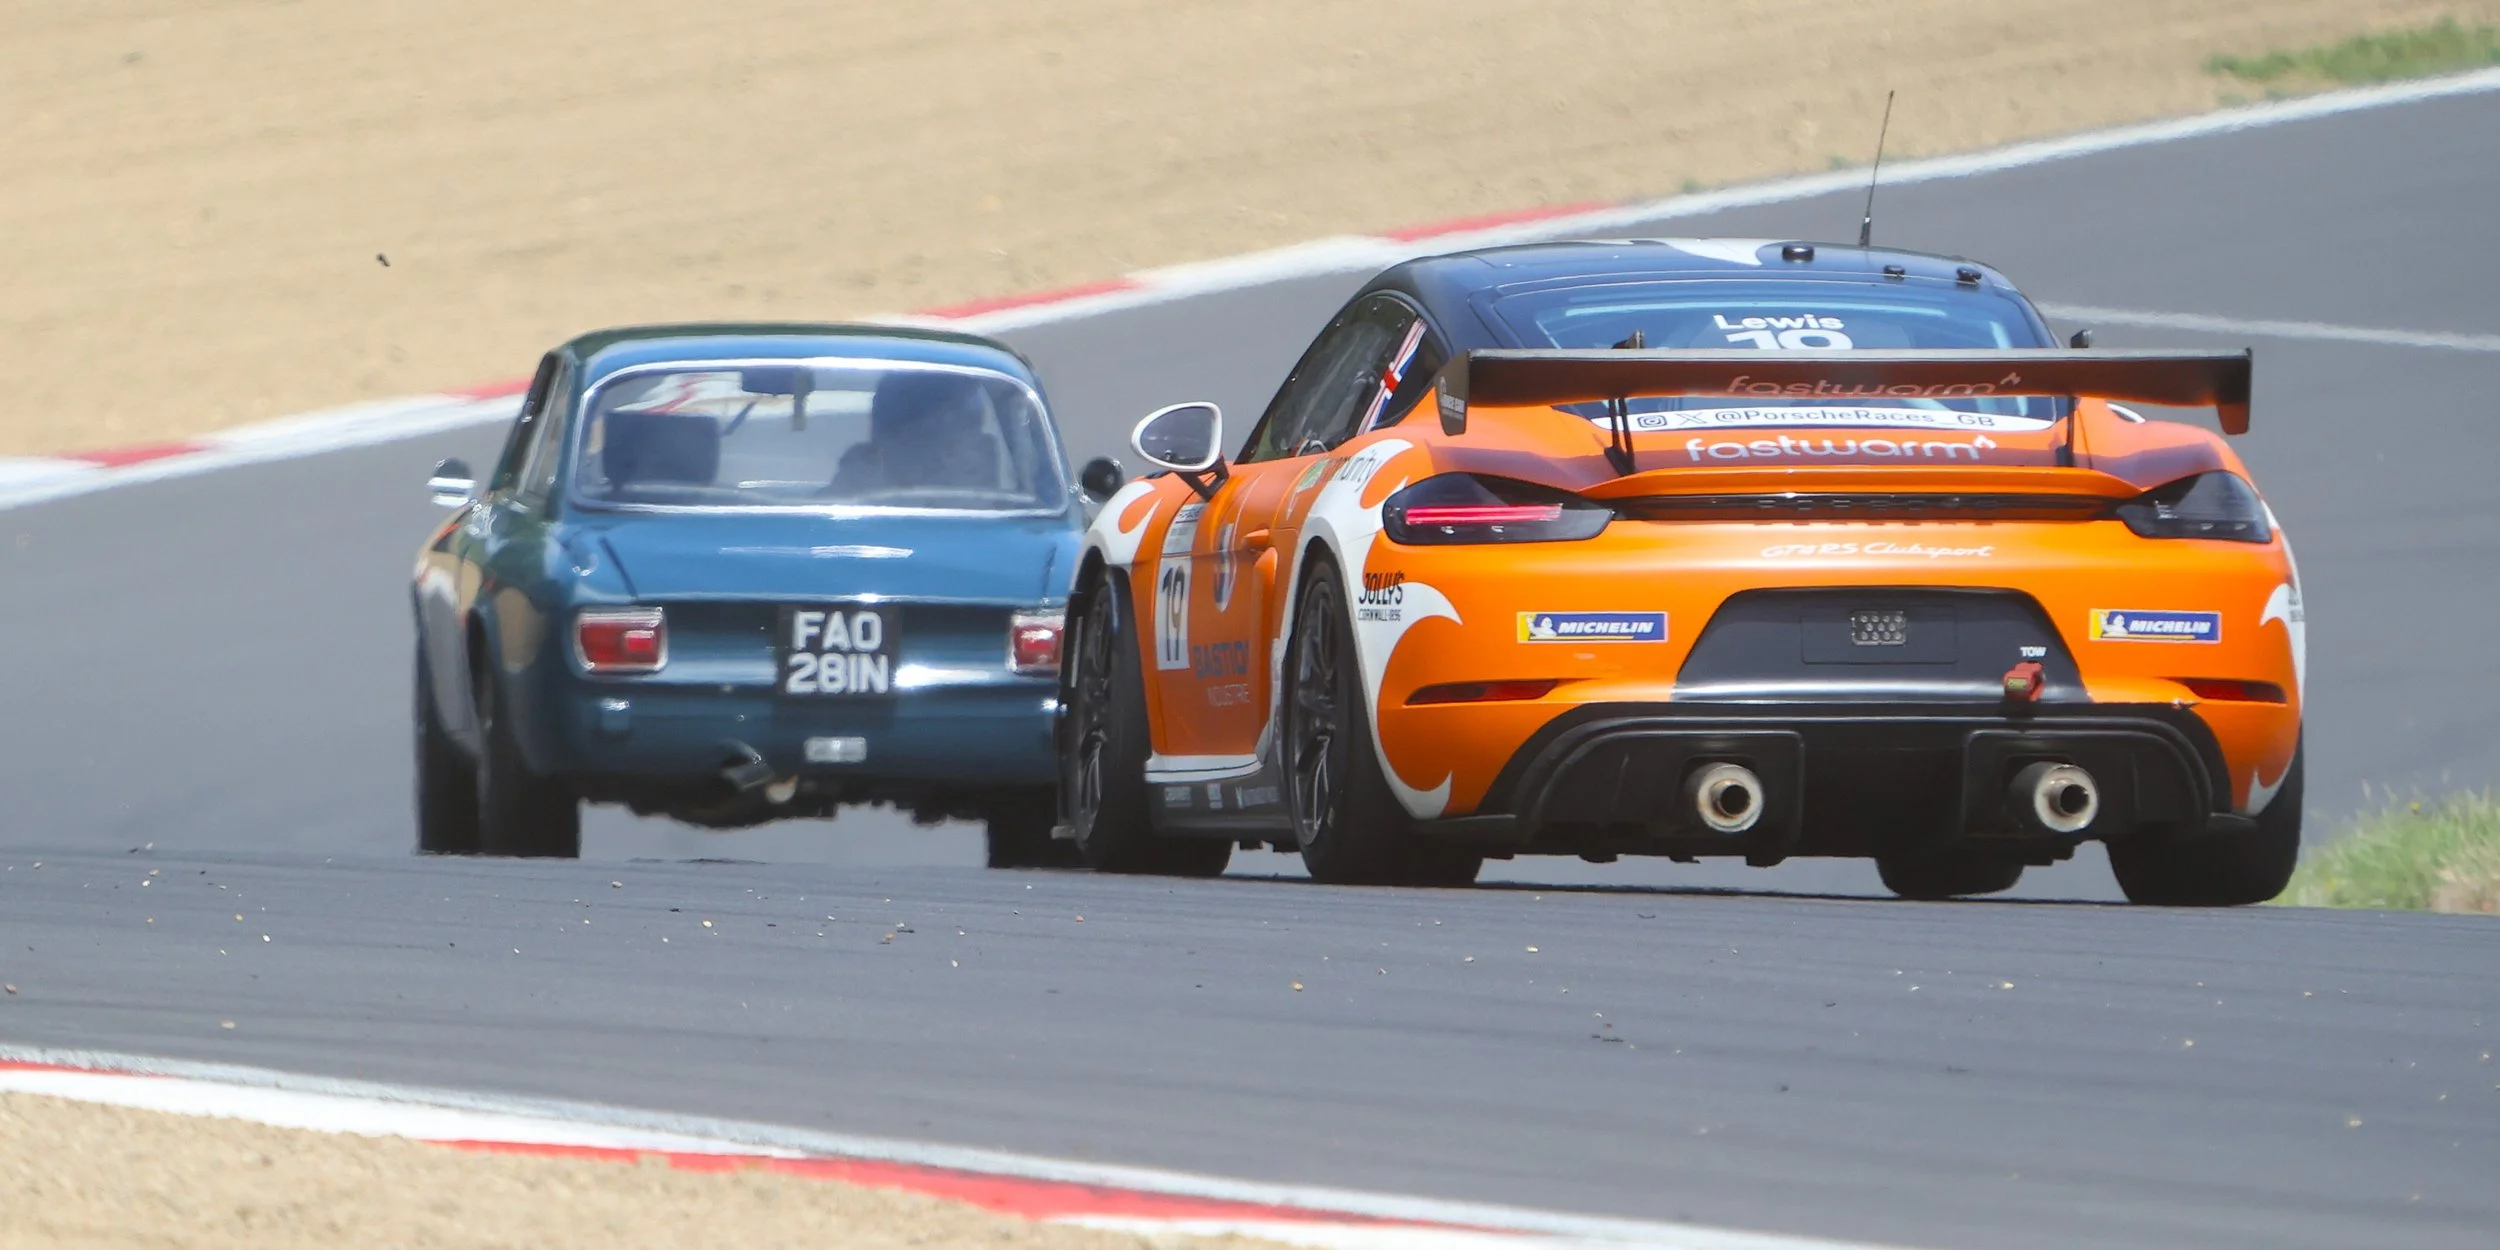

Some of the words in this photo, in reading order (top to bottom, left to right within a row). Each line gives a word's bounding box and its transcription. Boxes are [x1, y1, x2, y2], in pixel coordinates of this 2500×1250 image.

[1713, 313, 1845, 330] Lewis
[1727, 375, 1997, 397] fastwarm
[1686, 434, 1982, 462] fastwarm
[1817, 543, 1858, 556] RS
[1863, 542, 1997, 560] Clubsport
[1162, 565, 1186, 662] 19
[791, 610, 883, 652] FAO
[1557, 621, 1655, 634] MICHELIN
[2128, 620, 2212, 634] MICHELIN
[2020, 646, 2046, 657] TOW
